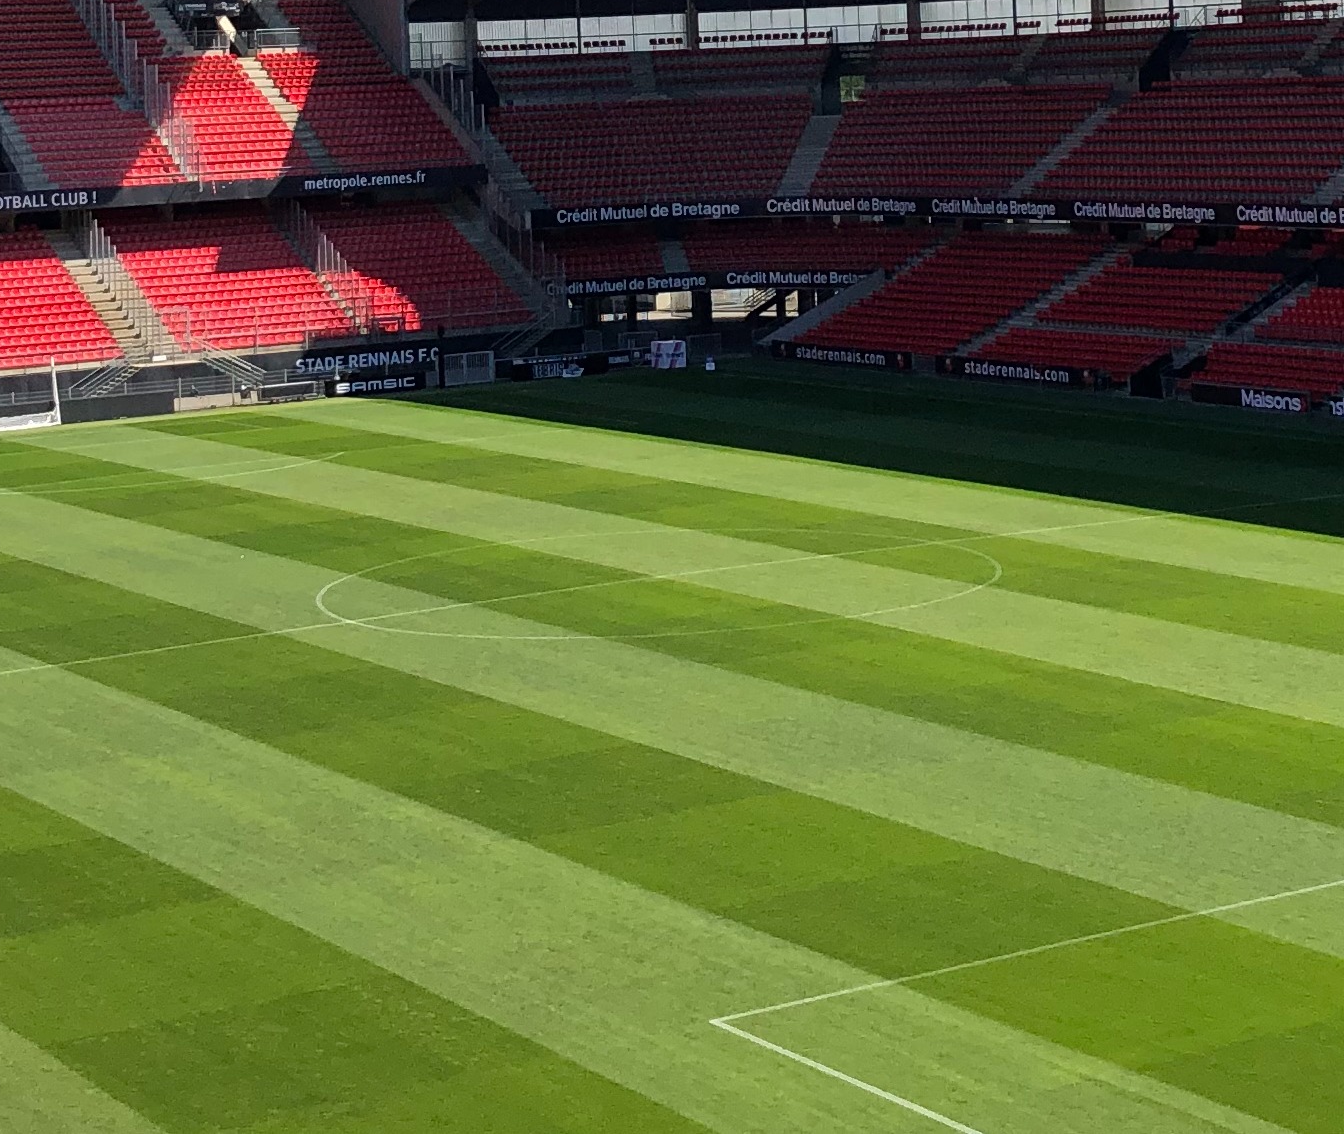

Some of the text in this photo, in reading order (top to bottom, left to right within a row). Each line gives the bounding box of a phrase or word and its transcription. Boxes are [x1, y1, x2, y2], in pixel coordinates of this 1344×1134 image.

[304, 170, 427, 191] metropole.rennes.fr
[51, 191, 89, 207] CLUB
[766, 197, 916, 216] Crédit Mutuel de Bretagne
[931, 199, 1056, 219] Crédit Mutuel de Bretagne
[556, 202, 741, 224] Crédit Mutuel de Bretagne
[1073, 201, 1216, 223] Crédit Mutuel de Bretagne
[1236, 205, 1274, 222] Crédit
[1275, 206, 1317, 223] Mutuel
[1320, 207, 1337, 224] de
[585, 279, 627, 293] Mutuel
[629, 277, 645, 291] de
[647, 275, 706, 290] Bretagne
[726, 272, 767, 285] Crédit
[769, 271, 811, 285] Mutuel
[813, 271, 828, 284] de
[296, 354, 345, 373] STADE
[348, 349, 415, 368] RENNAIS
[795, 345, 886, 366] staderennais.com
[964, 360, 1070, 383] staderennais.com
[336, 376, 416, 394] SAMSIC
